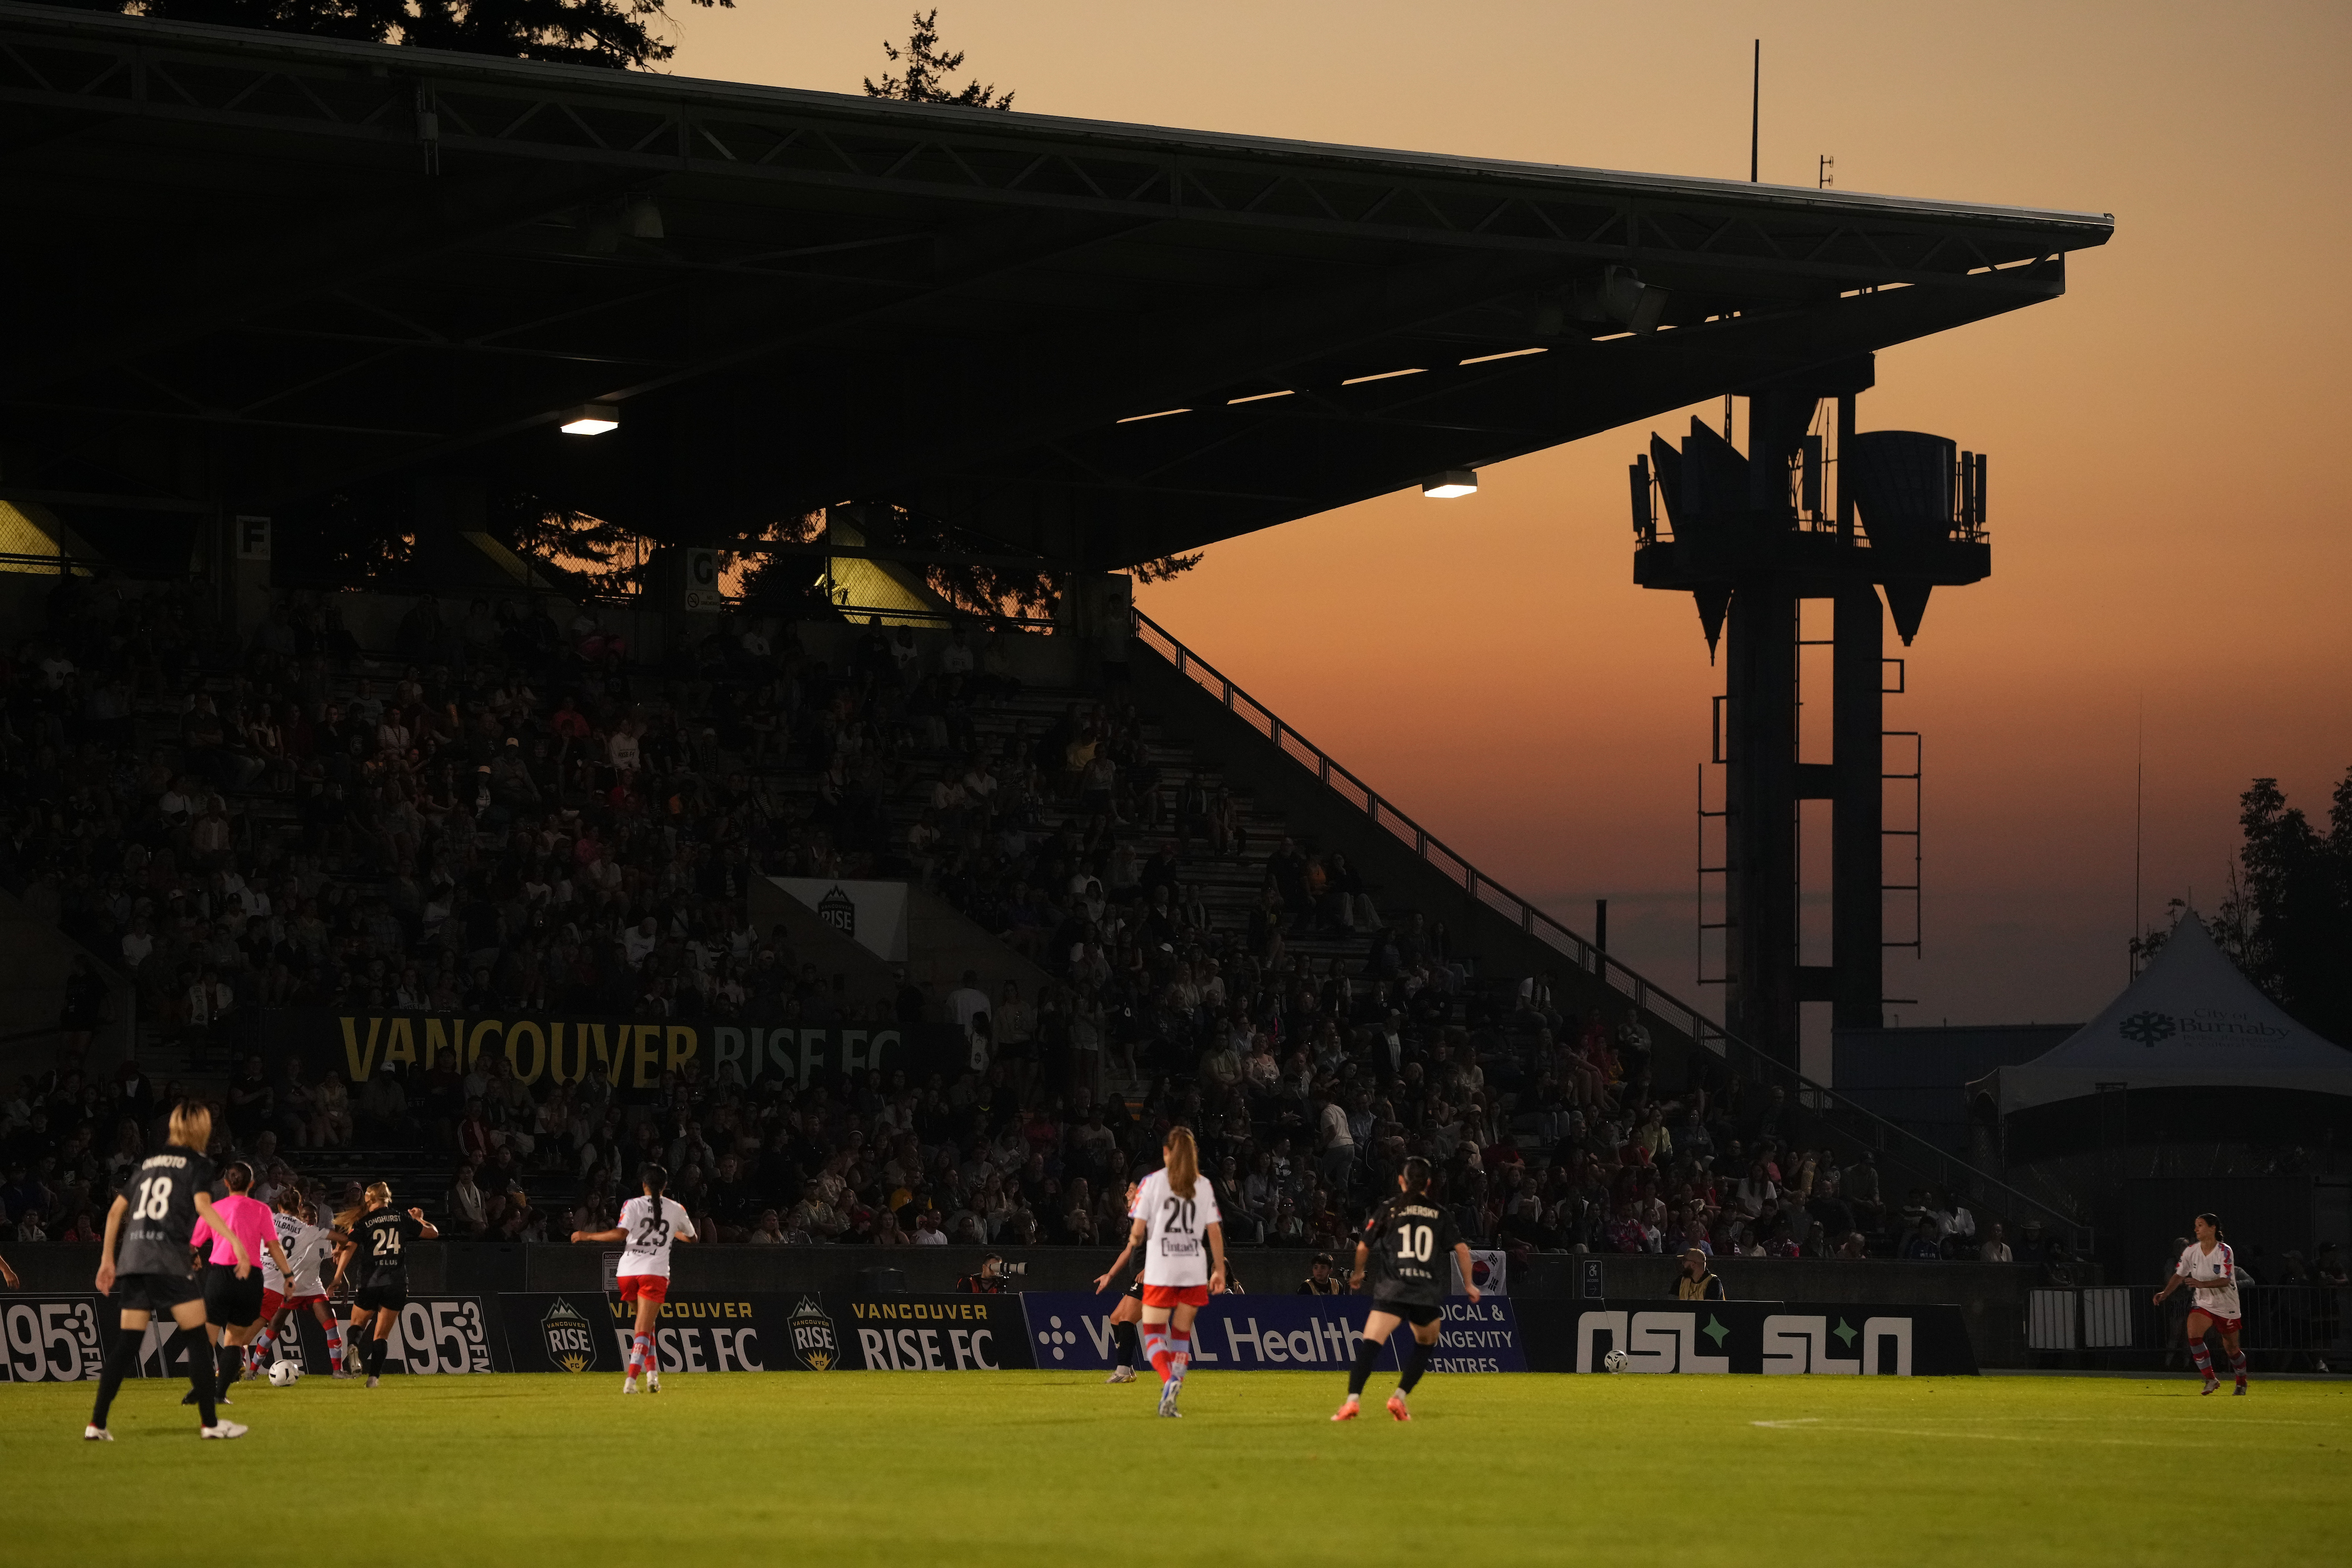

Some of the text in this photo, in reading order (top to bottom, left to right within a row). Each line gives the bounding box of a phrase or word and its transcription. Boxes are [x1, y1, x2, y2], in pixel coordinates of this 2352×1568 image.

[243, 521, 265, 553] F
[694, 553, 713, 585] G
[2180, 1018, 2291, 1039] Burnaby
[2194, 1008, 2248, 1020] City of
[339, 1016, 902, 1092] VANCOUVER RISE FC
[133, 1176, 172, 1221] 18
[365, 1215, 401, 1228] LONGHURST
[1164, 1197, 1196, 1233] 20
[373, 1227, 401, 1256] 24
[636, 1217, 670, 1247] 23
[1397, 1223, 1433, 1263] 10
[1399, 1268, 1432, 1280] TELUS
[852, 1303, 987, 1320] VANCOUVER
[1491, 1304, 1506, 1321] &
[548, 1328, 591, 1353] RISE
[710, 1328, 763, 1372] FC
[794, 1326, 834, 1350] RISE
[857, 1328, 999, 1371] RISE FC
[1223, 1317, 1365, 1363] Health
[82, 1347, 103, 1380] FM
[469, 1344, 491, 1374] FM
